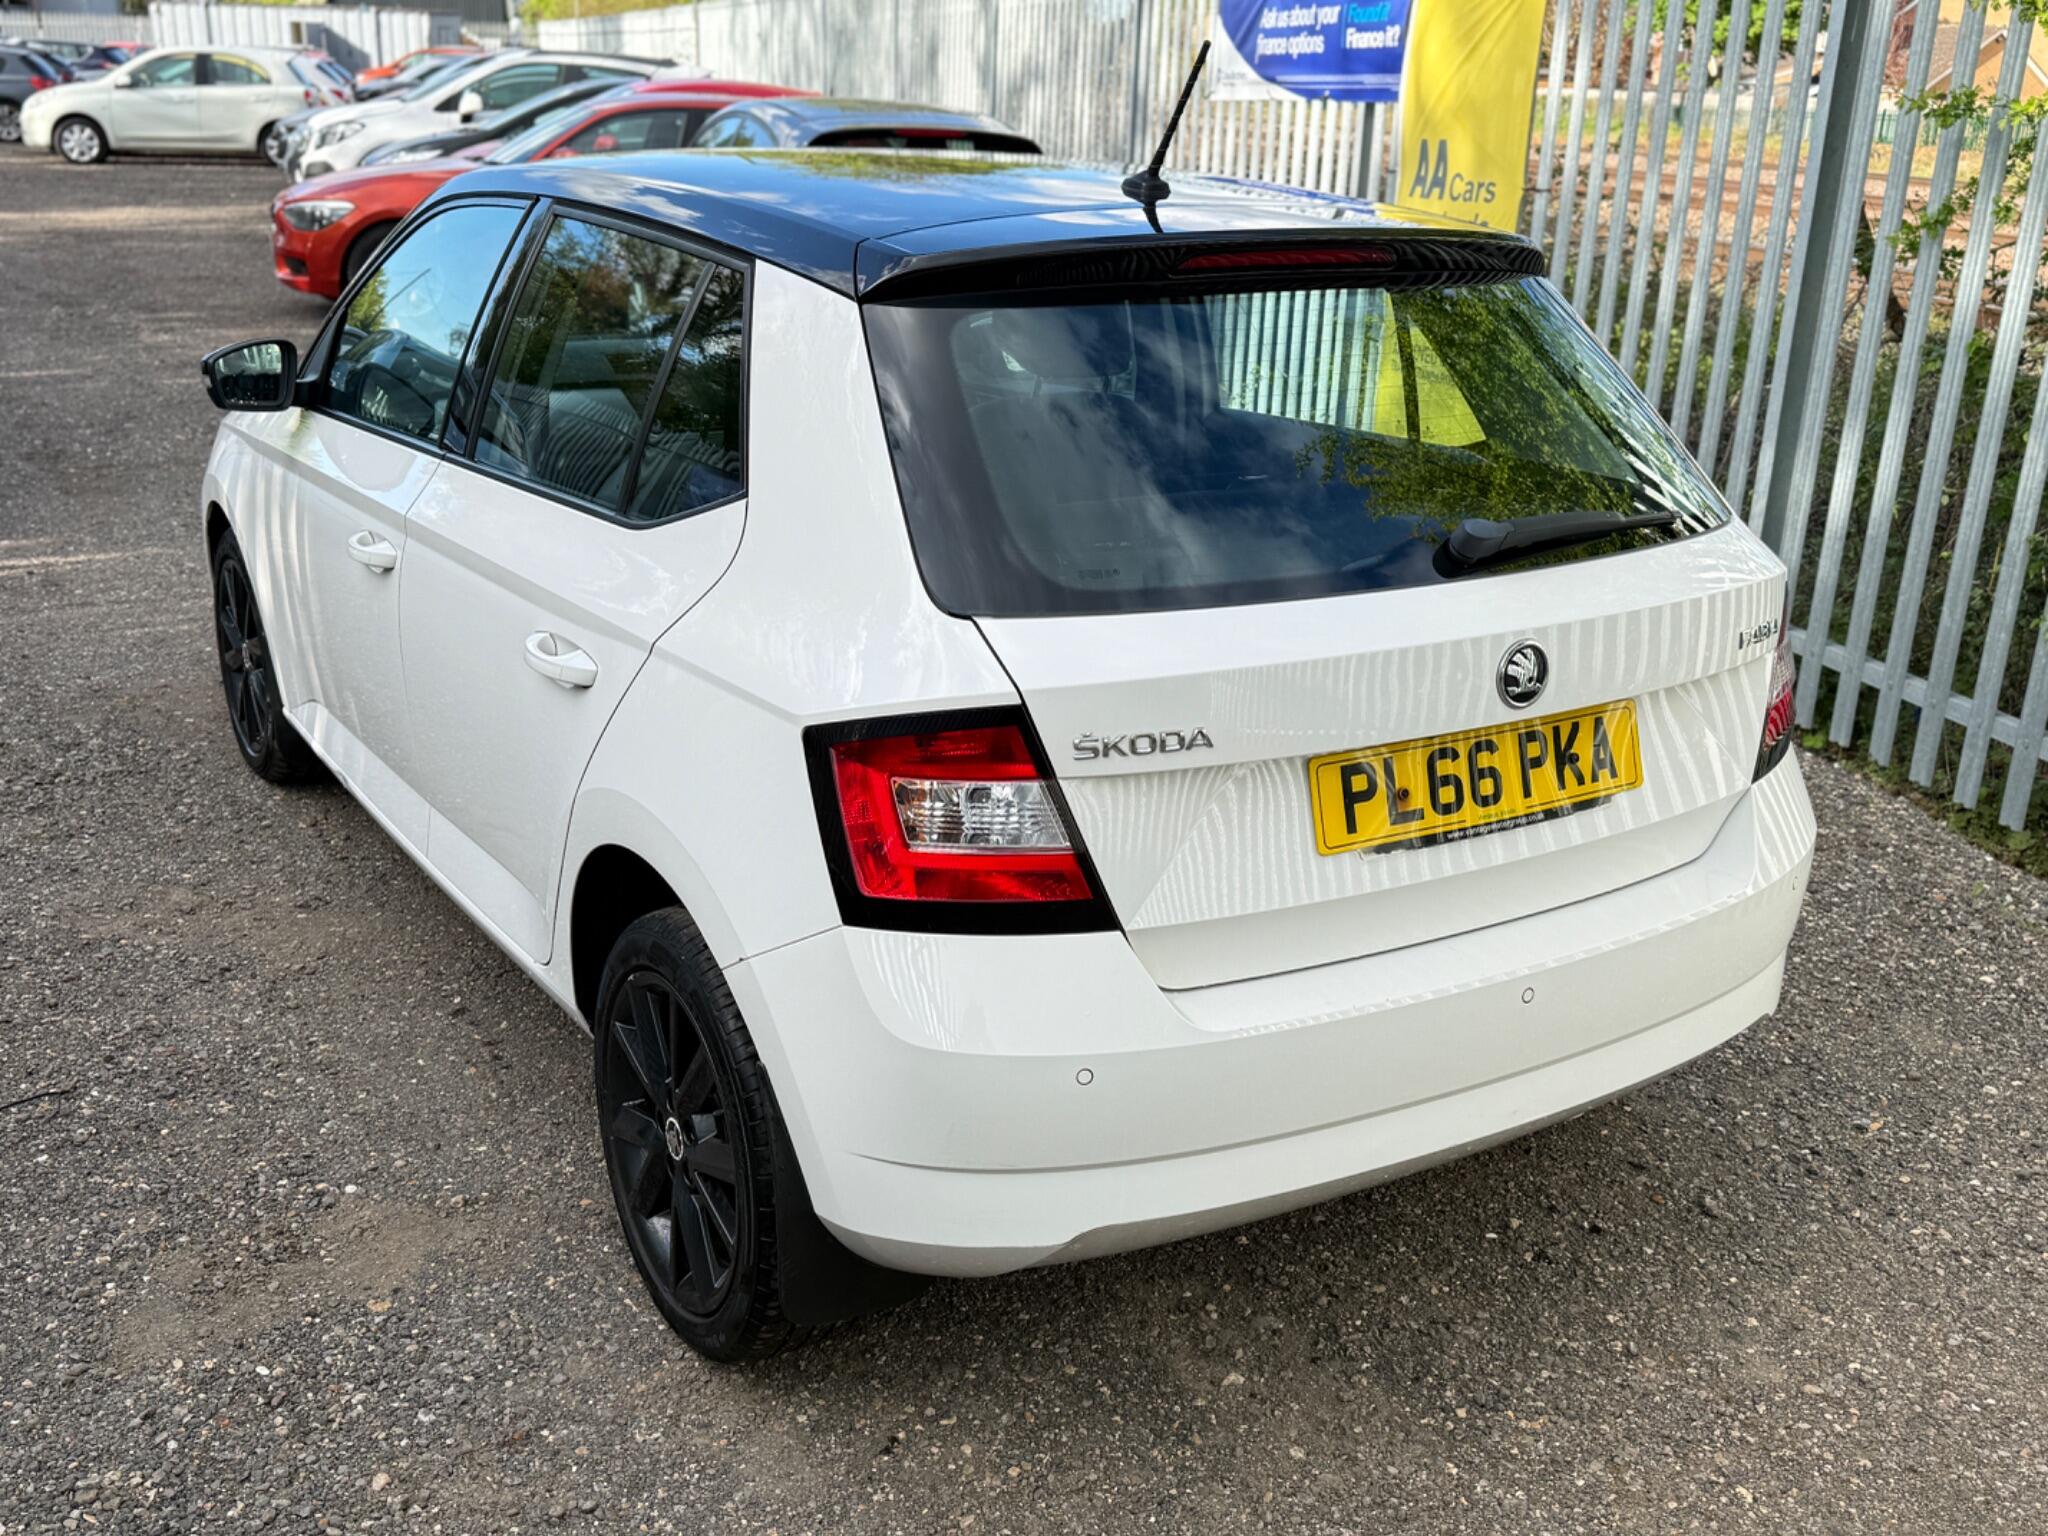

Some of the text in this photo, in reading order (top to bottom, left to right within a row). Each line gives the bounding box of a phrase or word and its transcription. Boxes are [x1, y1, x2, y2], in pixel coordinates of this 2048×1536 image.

[1259, 4, 1341, 30] Ask us about your
[1347, 2, 1383, 23] Found
[1256, 31, 1325, 64] finance options
[1346, 27, 1384, 49] Finance
[1408, 139, 1497, 203] AA Cars
[1073, 727, 1214, 760] ŠKODA
[1339, 715, 1618, 835] PL66 PKA
